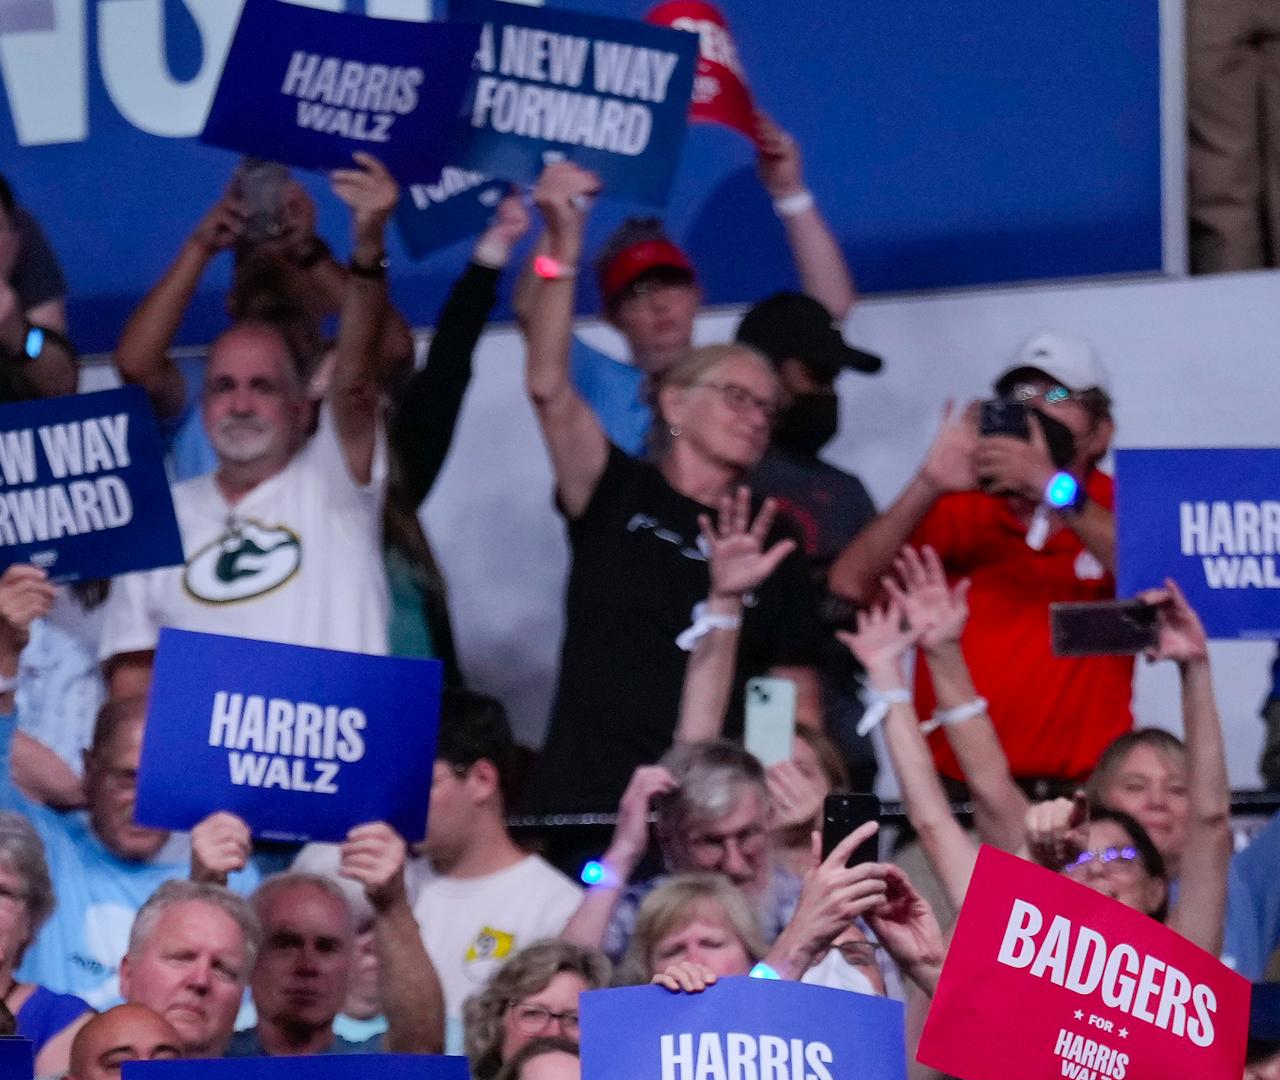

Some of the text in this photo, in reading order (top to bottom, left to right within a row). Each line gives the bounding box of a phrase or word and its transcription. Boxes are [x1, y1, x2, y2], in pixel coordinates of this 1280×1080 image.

[281, 51, 425, 116] HARRIS
[474, 22, 496, 72] A
[500, 25, 590, 88] NEW
[593, 40, 679, 103] WAY
[295, 98, 397, 143] WALZ
[472, 76, 653, 157] FORWARD
[42, 412, 130, 477] WAY
[208, 690, 367, 763] HARRIS
[227, 751, 339, 795] WALZ
[997, 898, 1218, 1049] BADGERS
[1087, 1013, 1114, 1034] FOR
